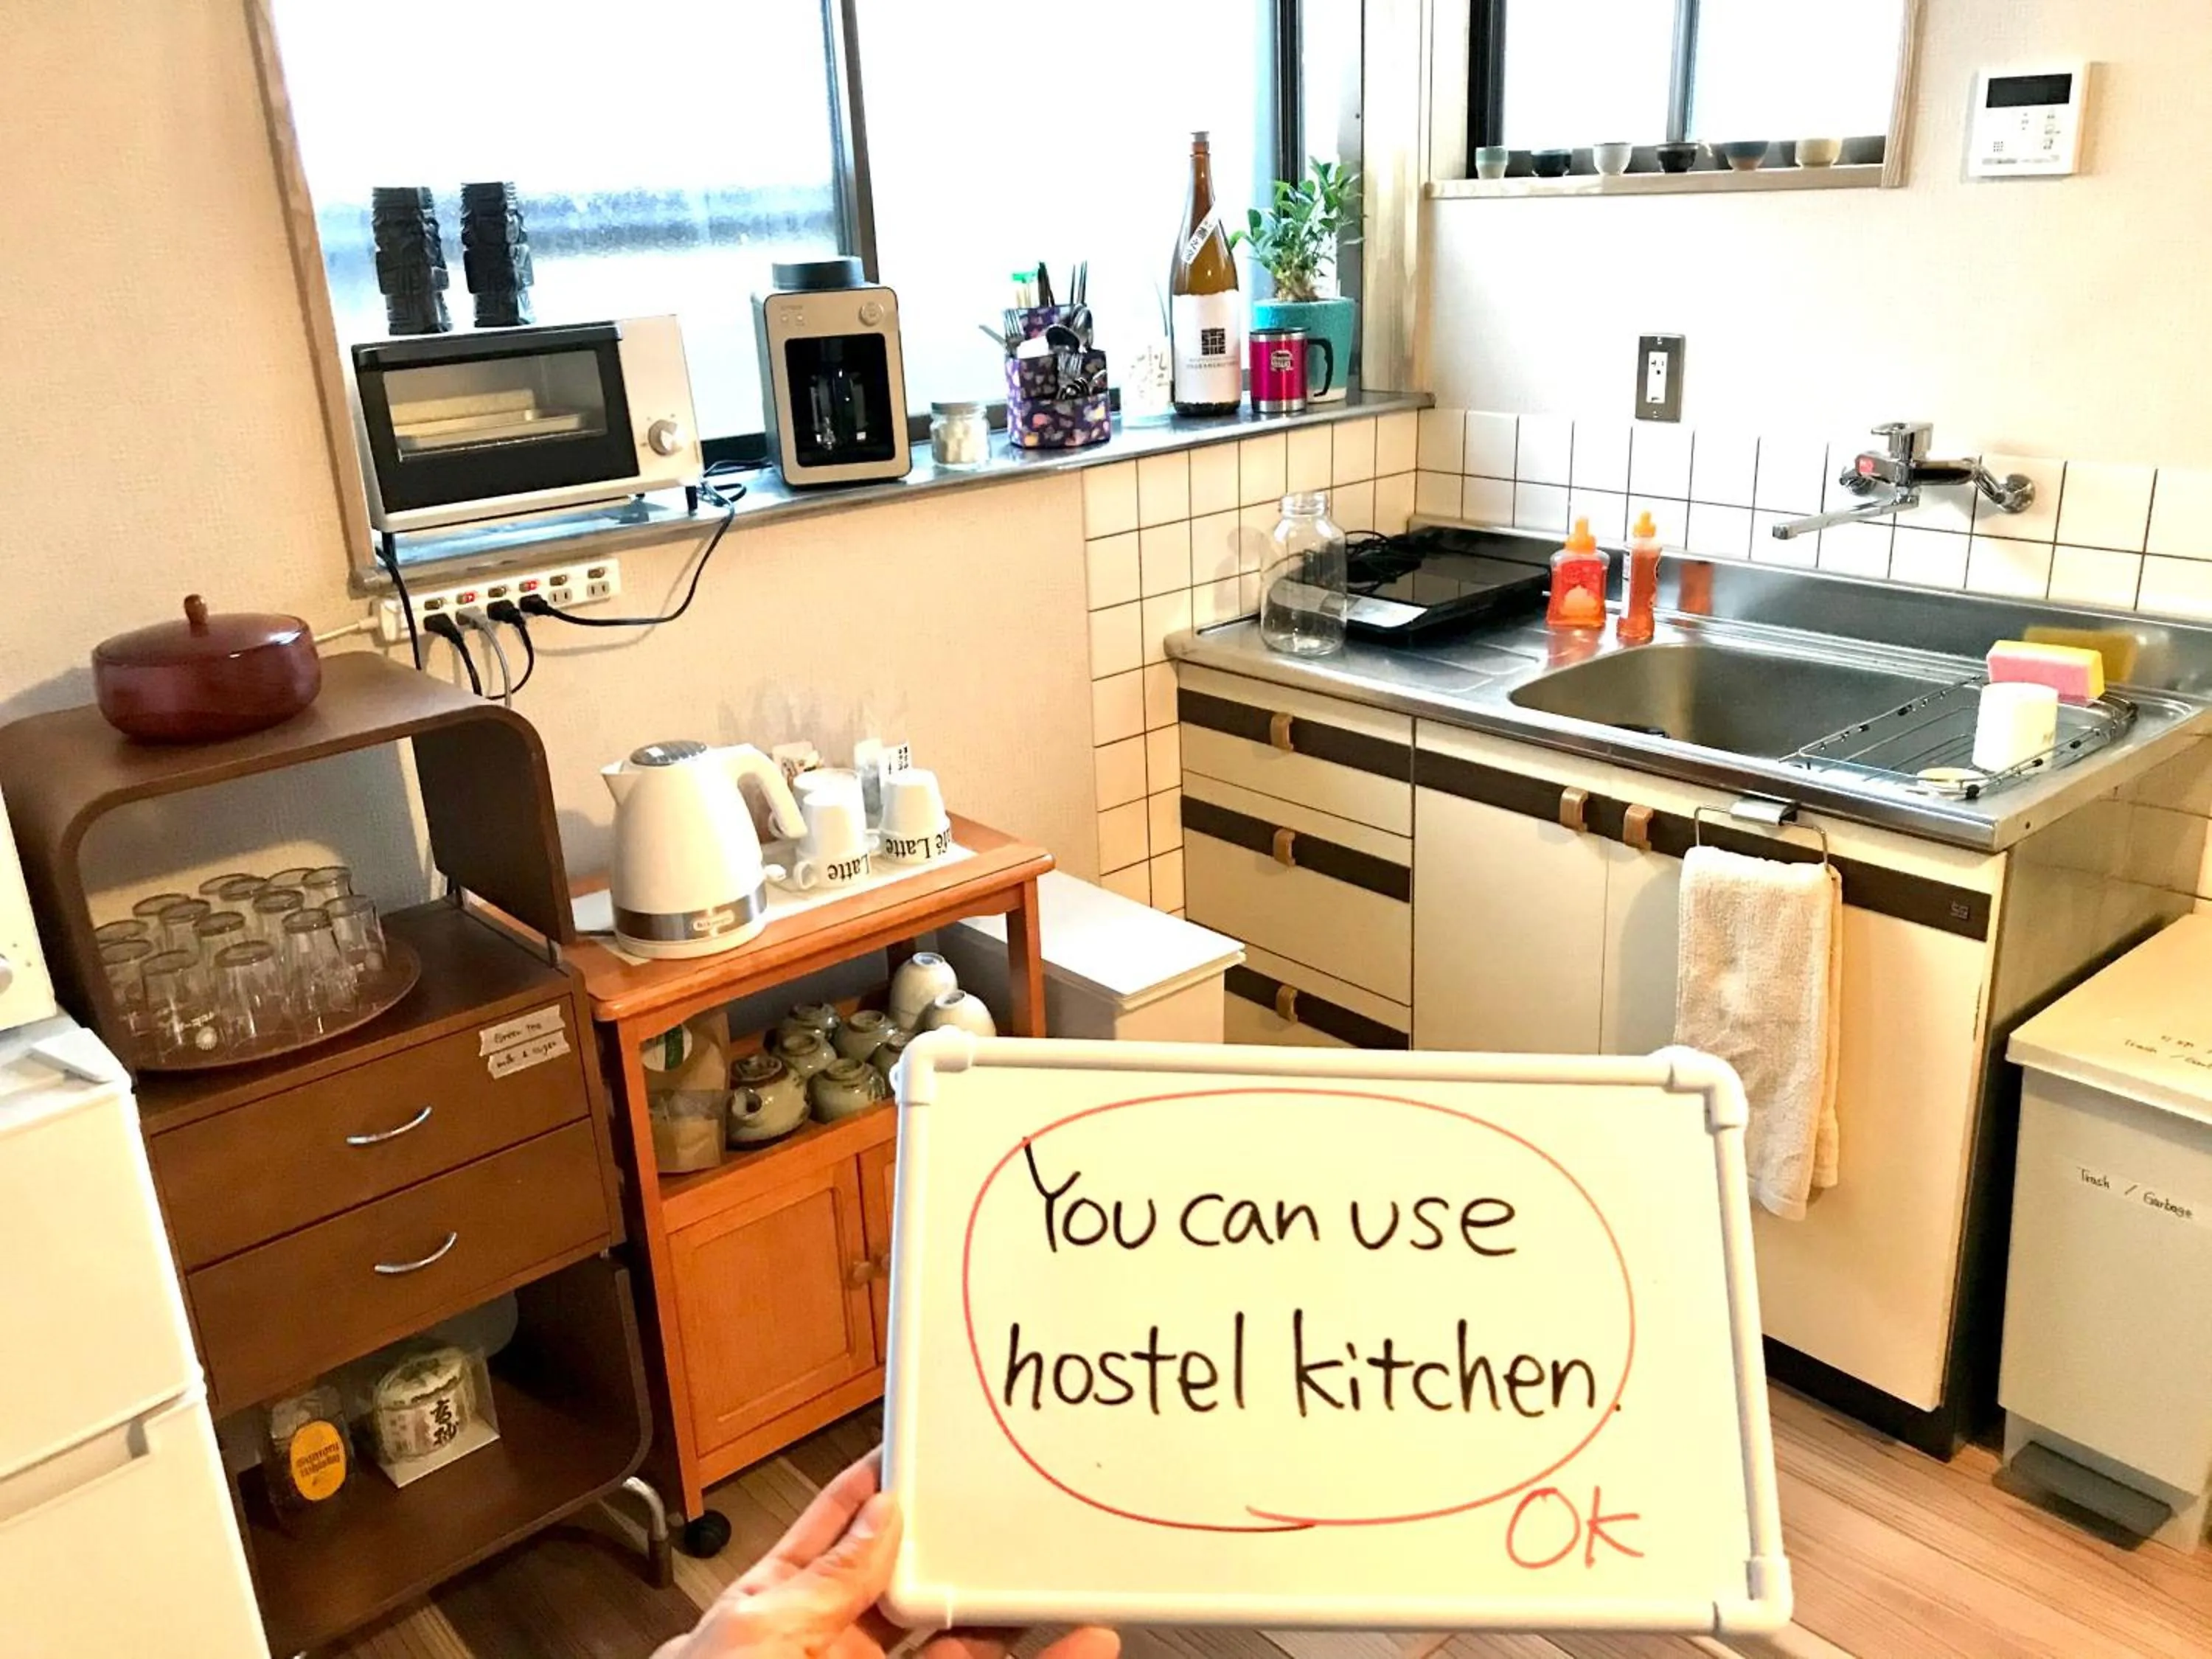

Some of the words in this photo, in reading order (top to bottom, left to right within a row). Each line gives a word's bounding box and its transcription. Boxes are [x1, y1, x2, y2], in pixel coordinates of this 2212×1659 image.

[827, 852, 871, 882] Latte
[886, 837, 931, 859] Latte
[1023, 1136, 1157, 1252] You
[1179, 1193, 1320, 1247] can
[1350, 1195, 1517, 1256] use
[2076, 1166, 2110, 1189] Trash
[2143, 1191, 2194, 1219] Garbage
[1004, 1311, 1245, 1415] hostel
[1293, 1308, 1621, 1418] kitchen.
[1506, 1486, 1644, 1569] OK
